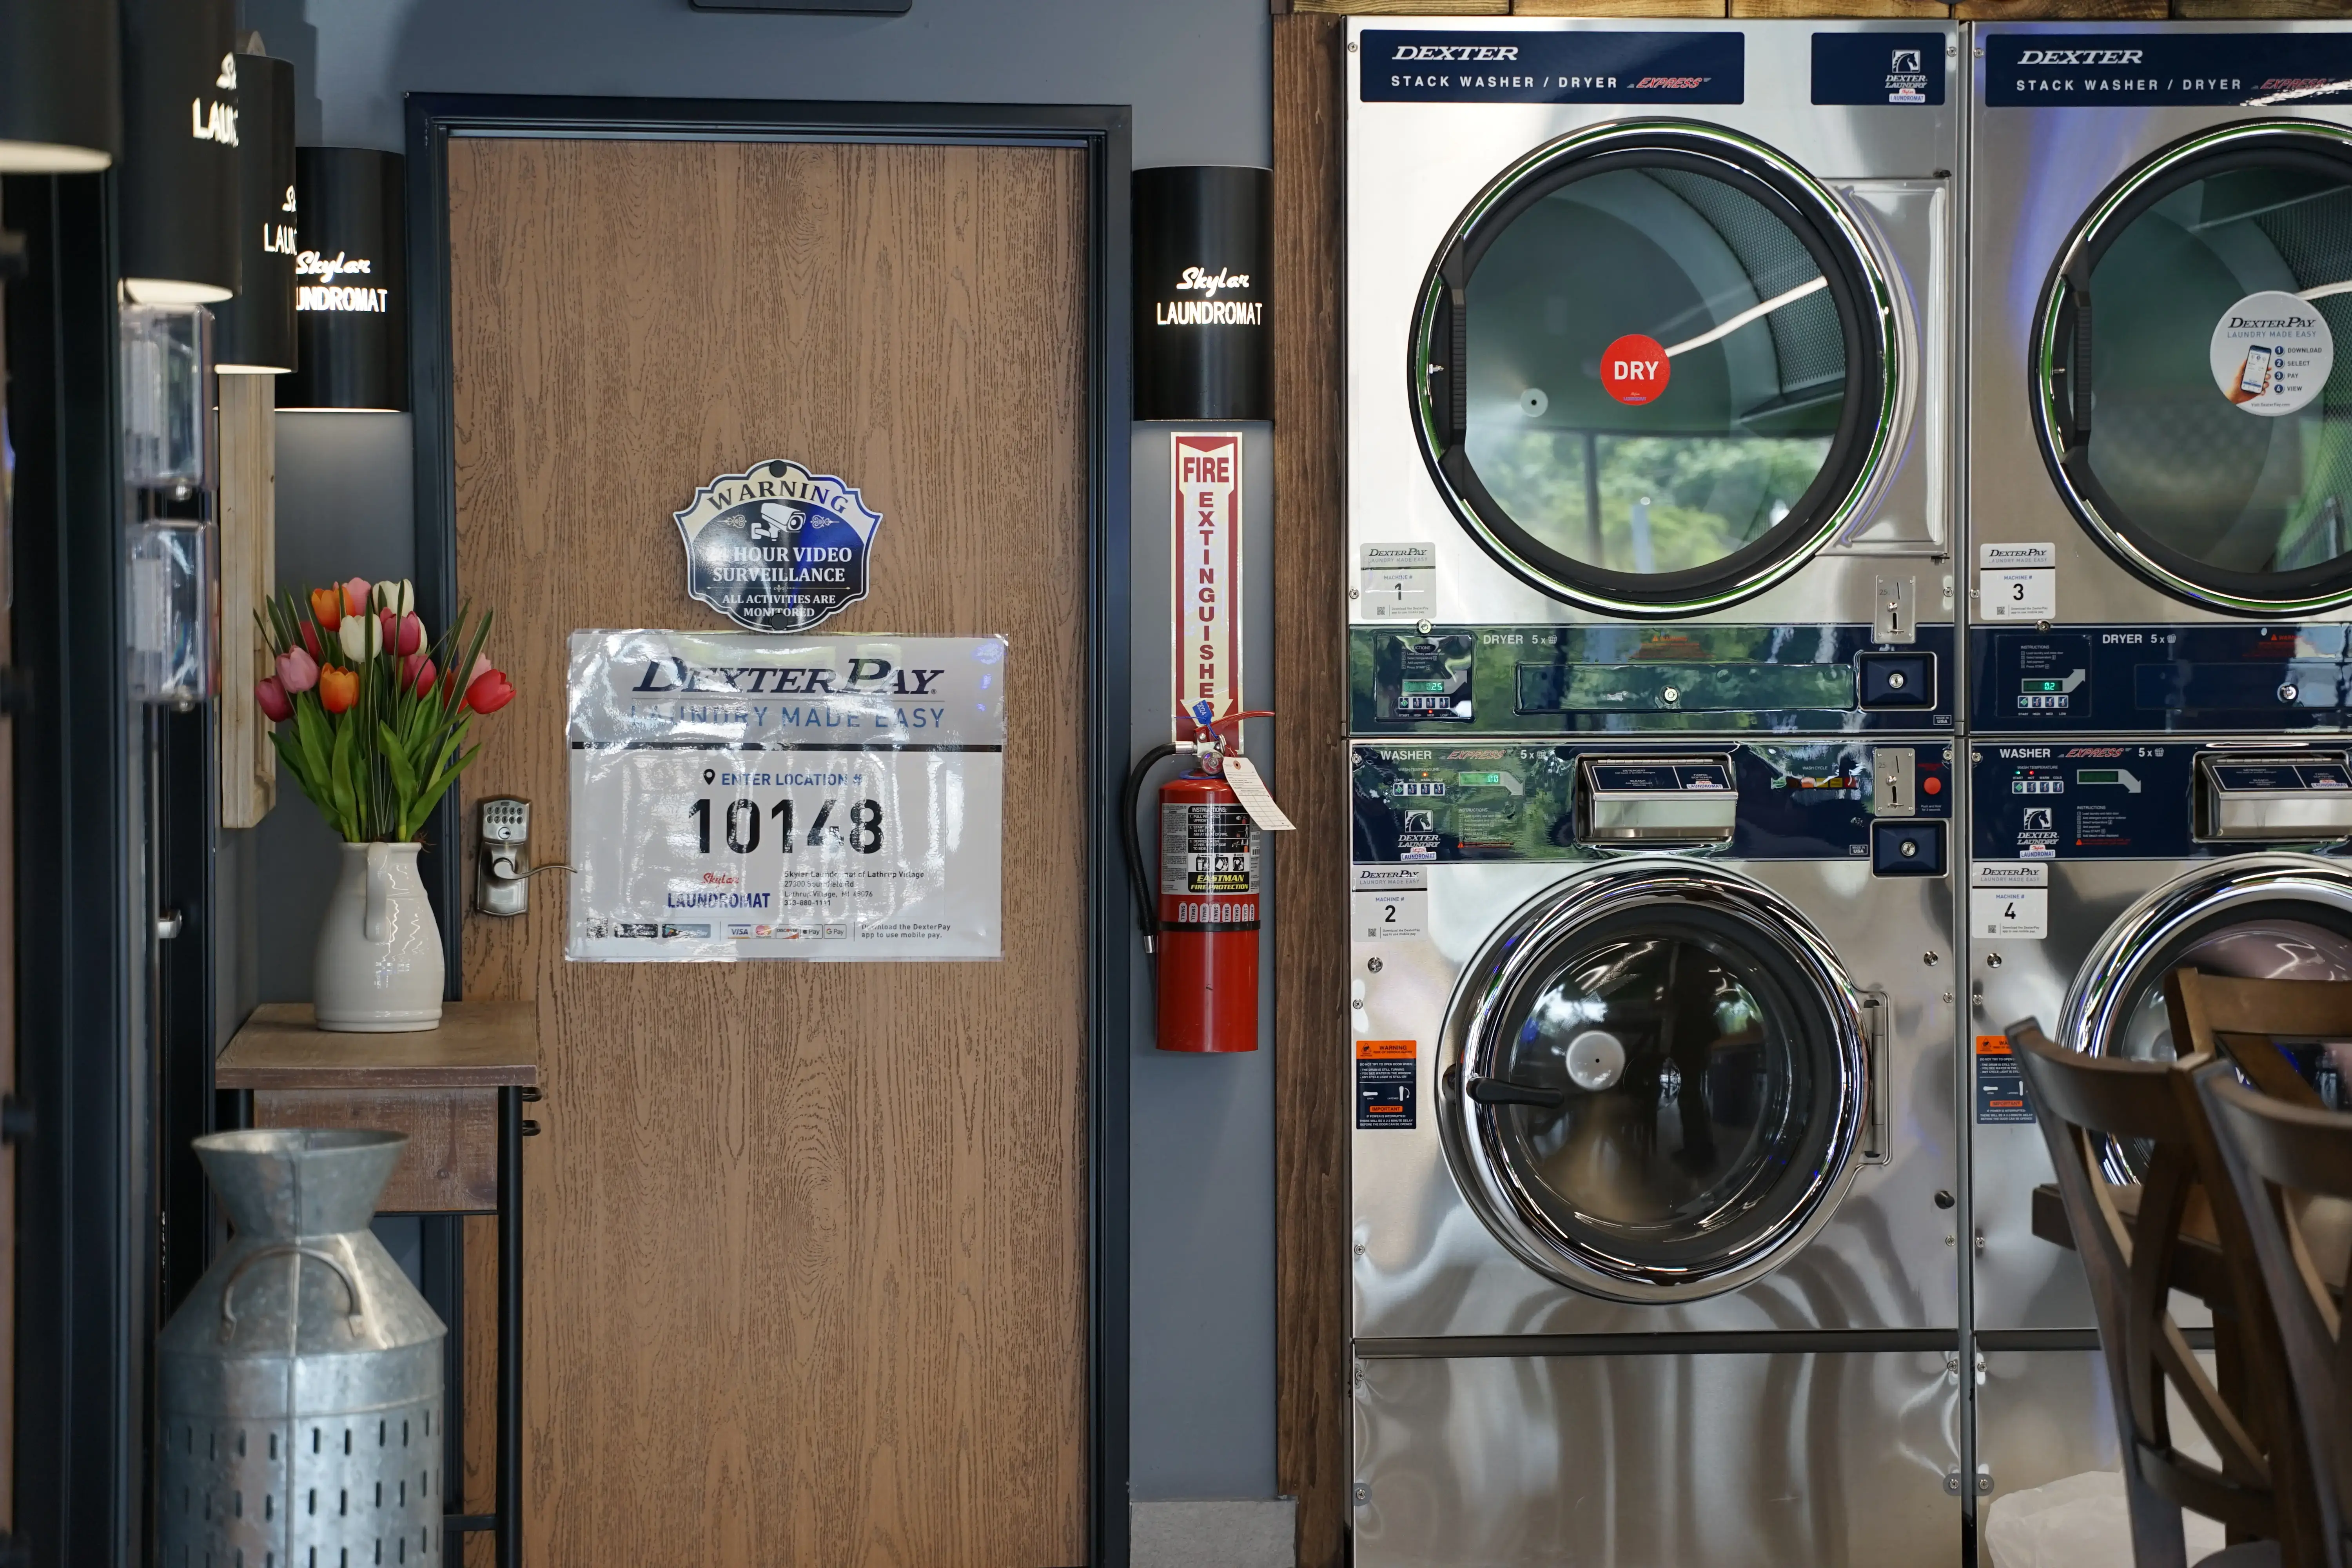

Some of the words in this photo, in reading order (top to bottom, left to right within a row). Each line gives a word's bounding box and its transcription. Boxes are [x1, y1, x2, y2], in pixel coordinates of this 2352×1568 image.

[1392, 46, 1519, 60] DEXTER
[2017, 50, 2143, 64] DEXTER
[1391, 76, 1450, 87] STACK
[1460, 76, 1534, 87] WASHER
[1559, 77, 1617, 88] DRYER
[1636, 77, 1703, 88] EXPRESS
[2016, 80, 2074, 91] STACK
[2085, 80, 2158, 90] WASHER
[2183, 79, 2241, 90] DRYER
[2260, 79, 2327, 89] EXPRESS
[296, 250, 371, 283] Skylar
[1176, 267, 1250, 298] Skylar
[296, 286, 388, 312] UNDROMAT
[1157, 301, 1263, 325] LAUNDROMAT
[1614, 361, 1659, 380] DRY
[1184, 457, 1229, 483] FIRE
[706, 480, 849, 514] WARNING
[733, 546, 788, 562] HOUR
[793, 547, 852, 562] VIDEO
[713, 568, 845, 582] SURVEILLANCE
[722, 595, 744, 604] ALL
[746, 595, 811, 604] ACTIVITIES
[812, 595, 836, 604] ARE
[1394, 583, 1401, 601] 1
[2013, 583, 2024, 601] 3
[743, 608, 815, 617] MONITORED
[1483, 635, 1523, 644] DRYER
[1532, 635, 1538, 644] 5
[2102, 634, 2142, 644] DRYER
[2151, 634, 2157, 644] 5
[1197, 702, 1207, 716] 2024
[784, 707, 860, 728] MADE
[876, 707, 944, 728] EASY
[1381, 750, 1432, 760] WASHER
[1446, 750, 1506, 760] EXPRESS
[1521, 750, 1527, 759] 5
[2000, 748, 2051, 758] WASHER
[2065, 748, 2124, 757] EXPRESS
[2138, 748, 2145, 757] 5
[722, 773, 771, 785] ENTER
[776, 773, 848, 786] LOCATION
[689, 799, 884, 854] 10148
[701, 872, 740, 887] Skylar
[668, 893, 771, 908] LAUNDROMAT
[1385, 905, 1396, 922] 2
[2004, 902, 2016, 919] 4
